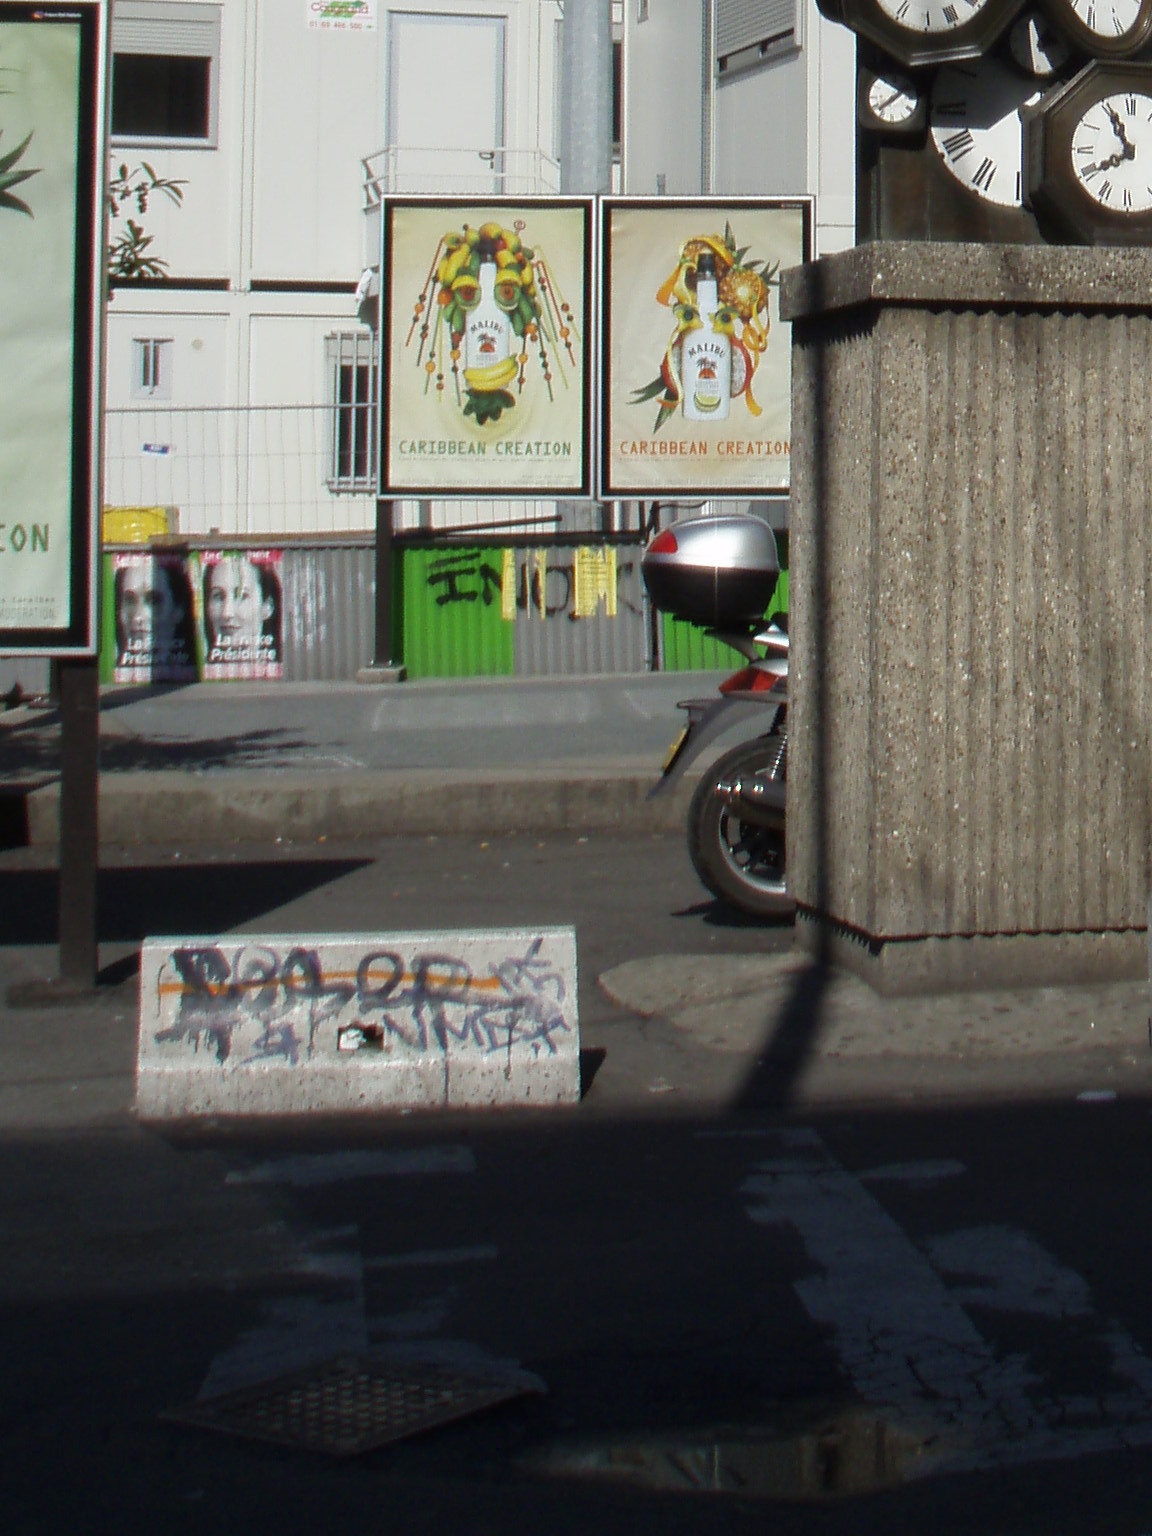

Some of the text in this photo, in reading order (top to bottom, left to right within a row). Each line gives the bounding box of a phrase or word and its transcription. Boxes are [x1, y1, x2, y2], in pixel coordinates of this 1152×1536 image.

[399, 440, 572, 457] CARIBBEAN CREATION
[620, 440, 792, 456] CARIBBEAN CREATION
